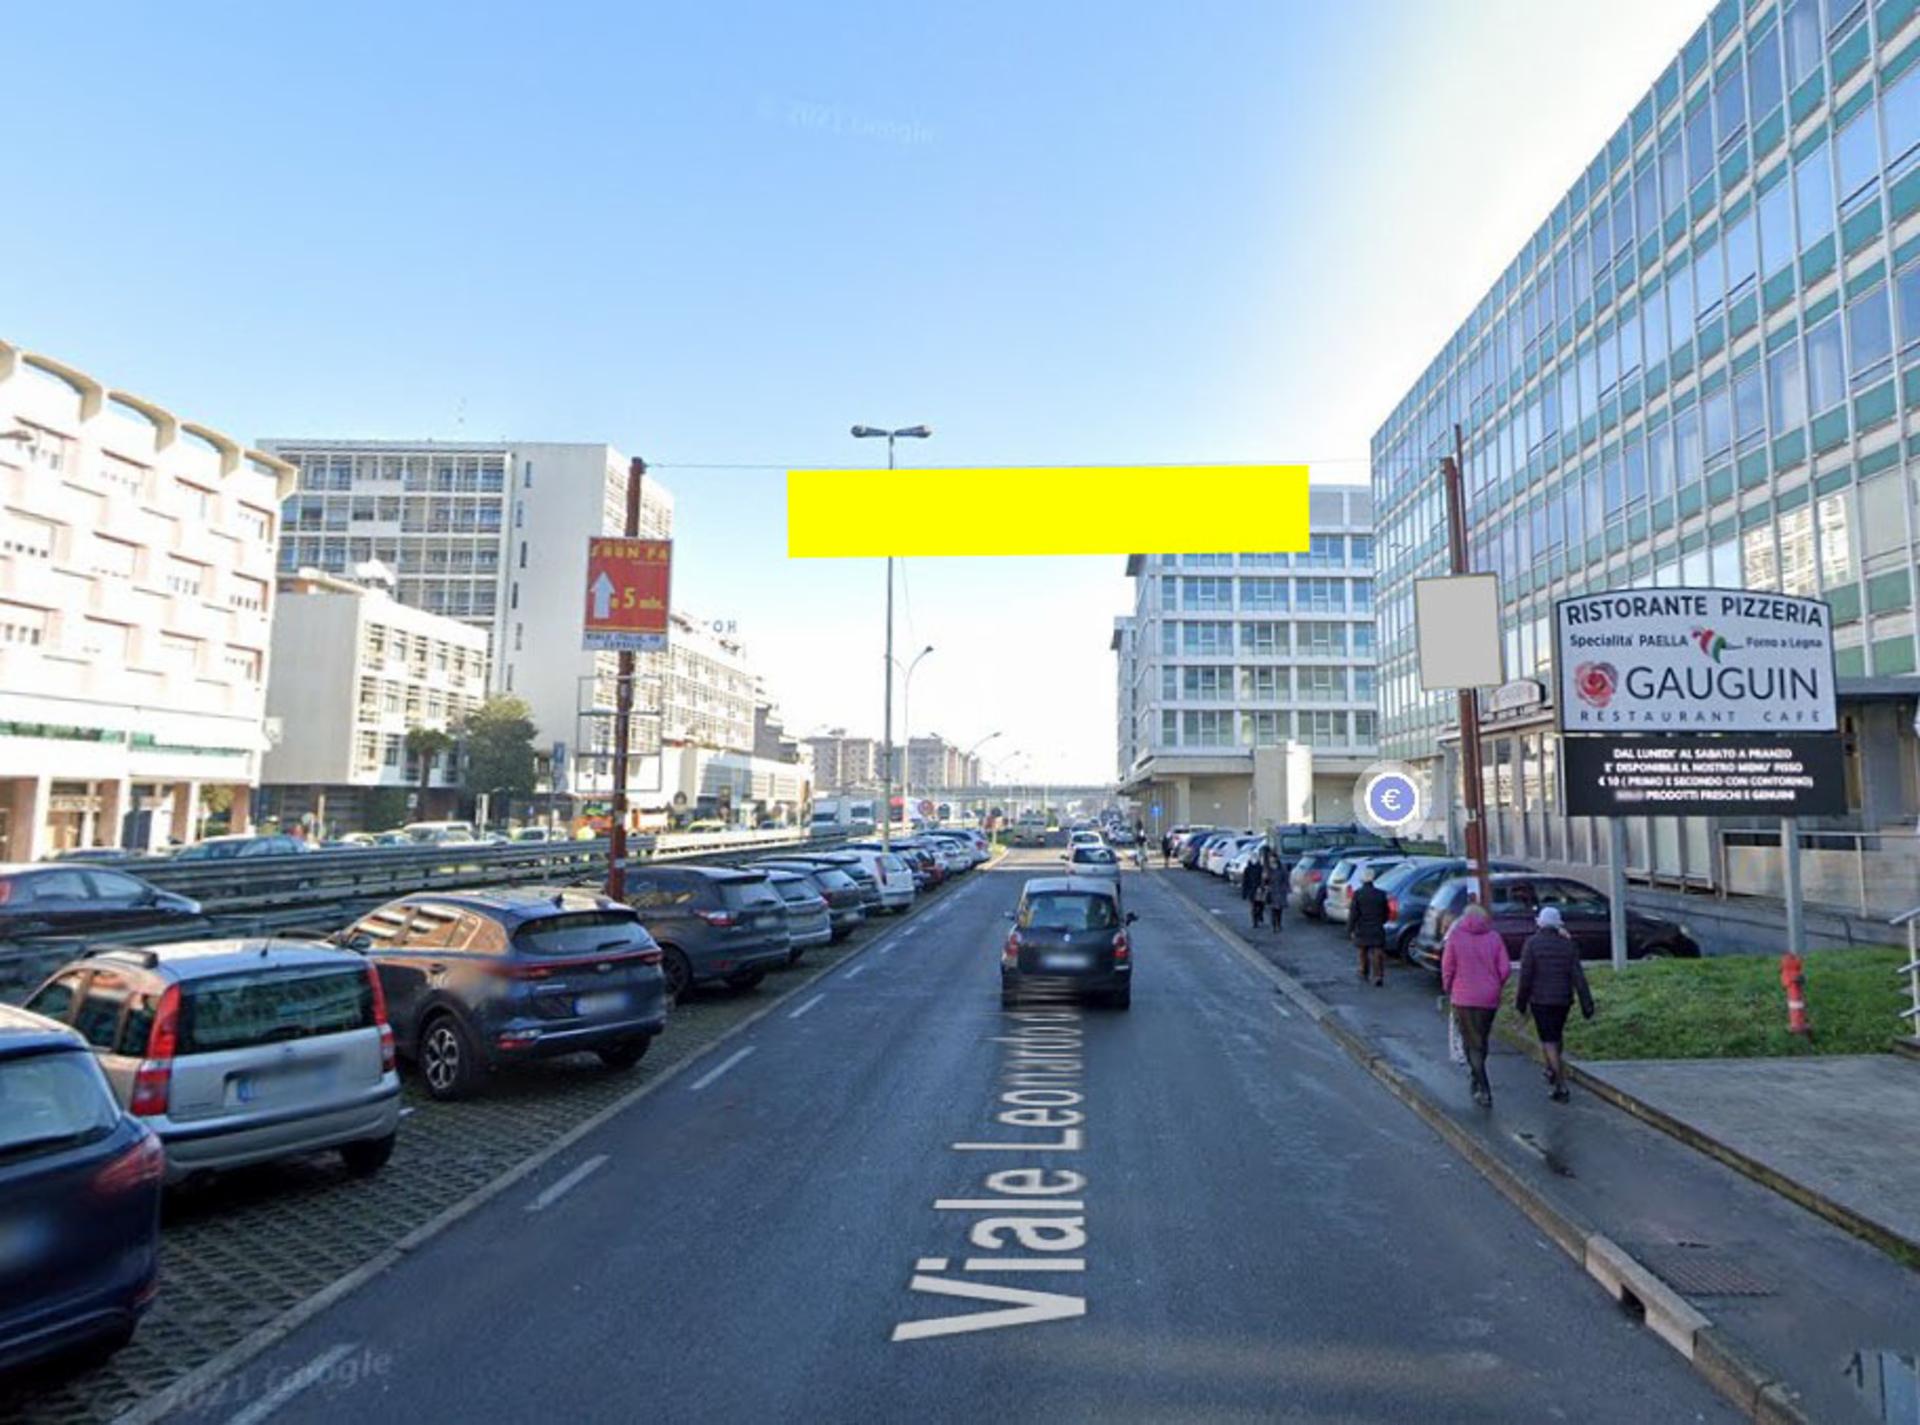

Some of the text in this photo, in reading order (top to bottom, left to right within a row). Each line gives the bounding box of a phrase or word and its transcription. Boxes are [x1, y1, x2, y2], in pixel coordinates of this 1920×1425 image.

[624, 587, 636, 609] 5
[1566, 596, 1822, 627] RISTORANTE PIZZERIA
[1639, 634, 1689, 647] PAELLA
[1746, 637, 1778, 648] Forno
[1789, 637, 1822, 650] Legna
[1625, 666, 1819, 701] GAUGUIN
[1580, 710, 1736, 723] RESTAURANT
[1613, 748, 1635, 759] DAL
[1679, 748, 1693, 759] AL
[1694, 748, 1736, 759] SABATO
[1738, 748, 1746, 759] A
[1748, 748, 1792, 759] PRANZO
[1616, 762, 1679, 773] DISPONIBILE
[1692, 762, 1736, 773] NOSTRO
[1774, 762, 1803, 773] FISSO
[1673, 776, 1723, 787] SECONDO
[1725, 776, 1748, 787] CON
[1645, 790, 1699, 801] PRODOTTI
